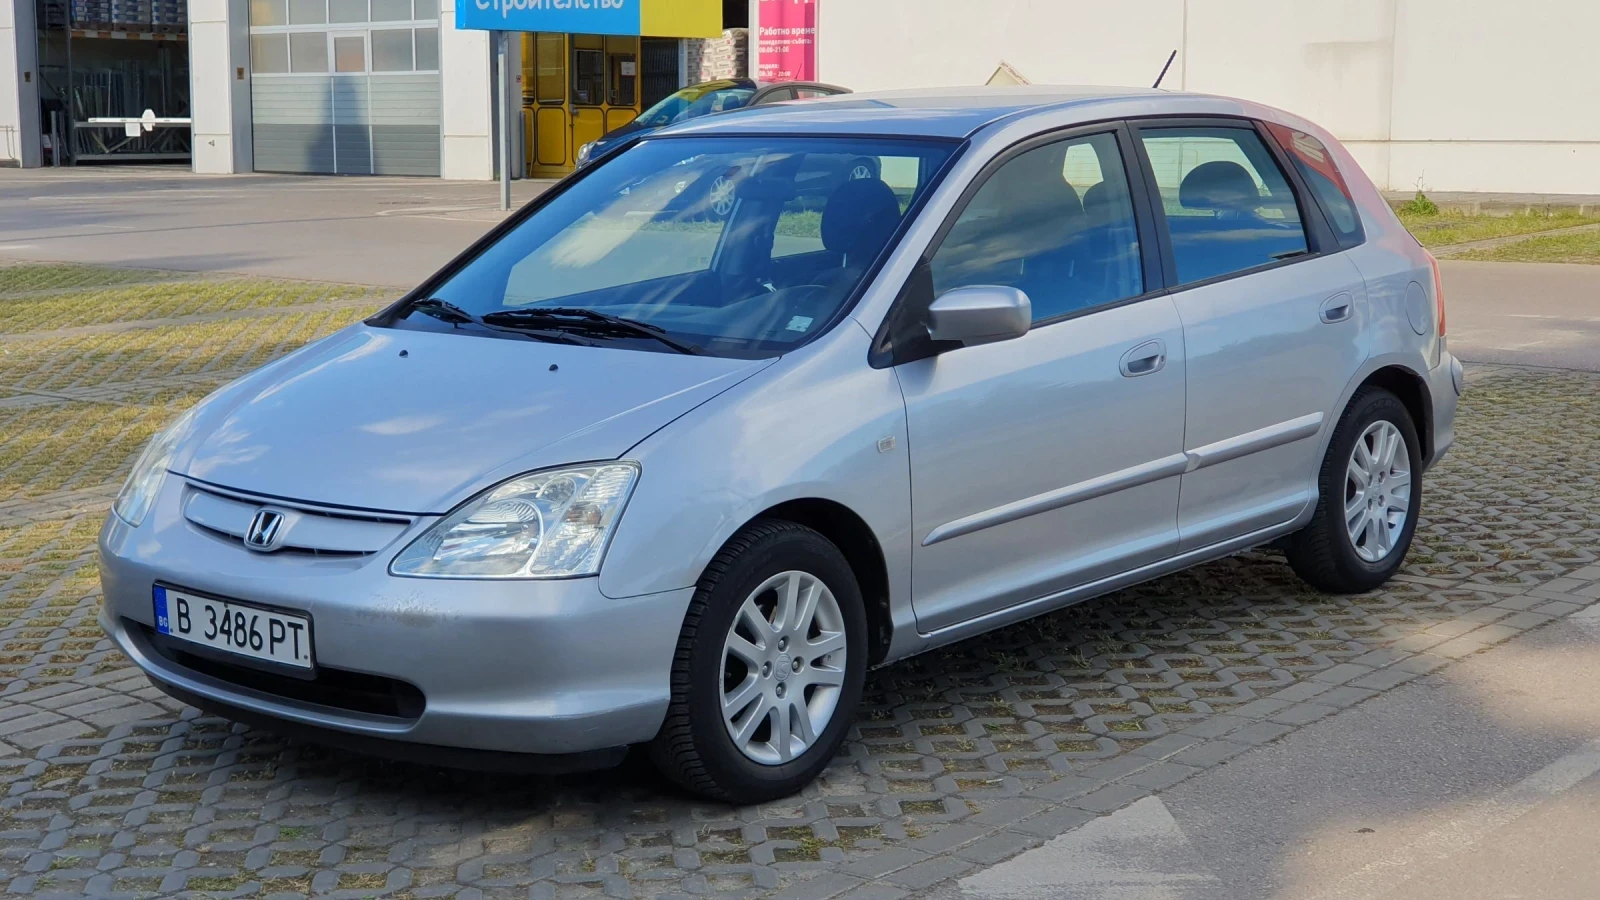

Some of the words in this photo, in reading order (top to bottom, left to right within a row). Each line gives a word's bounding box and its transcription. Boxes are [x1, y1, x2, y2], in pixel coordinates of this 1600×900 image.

[759, 27, 790, 36] Работно
[791, 28, 815, 36] време
[158, 615, 168, 628] BG
[176, 597, 192, 634] B
